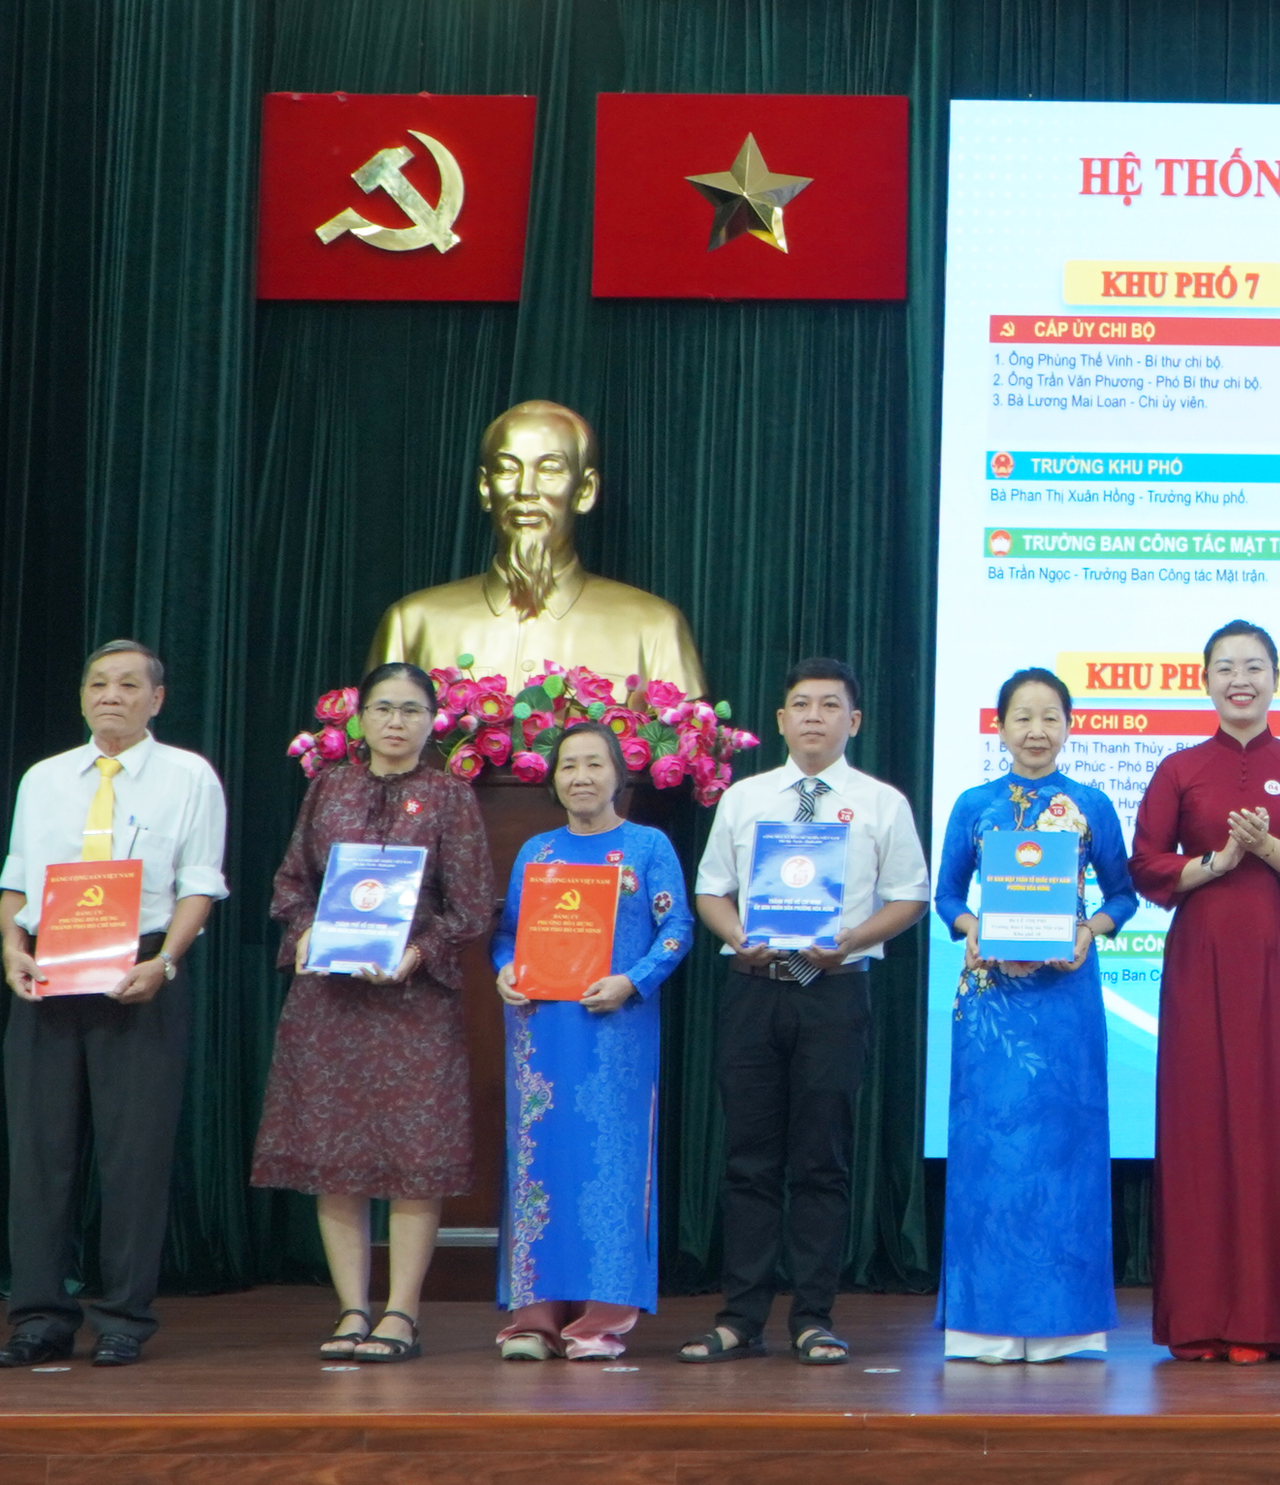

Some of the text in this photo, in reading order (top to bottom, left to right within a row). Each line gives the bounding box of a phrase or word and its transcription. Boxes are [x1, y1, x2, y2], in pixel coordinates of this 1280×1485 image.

[1079, 152, 1142, 206] HỆ
[1101, 266, 1259, 299] KHU PHỐ 7
[1034, 319, 1155, 342] CẤP ỦY CHI BỘ
[1009, 351, 1034, 368] Ông
[1038, 353, 1076, 369] Phùng
[1080, 352, 1102, 367] Thế
[1107, 355, 1133, 367] Vinh
[1145, 355, 1157, 367] Bí
[1162, 356, 1181, 368] thư
[1185, 356, 1201, 368] chi
[1206, 354, 1224, 370] bộ.
[1008, 371, 1033, 389] Ông
[1037, 372, 1063, 387] Trần
[1068, 375, 1091, 387] Văn
[1095, 374, 1144, 391] Phương
[1156, 375, 1179, 388] Phó
[1184, 376, 1195, 388] Bí
[1200, 377, 1219, 389] thư
[1224, 377, 1240, 389] chi
[1244, 377, 1261, 391] bộ.
[1022, 533, 1096, 551] TRƯỞNG
[1100, 535, 1135, 551] BAN
[1139, 534, 1188, 552] CÔNG
[1192, 535, 1226, 553] TÁC
[1230, 536, 1266, 556] MẶT
[1086, 663, 1207, 690] KHU PH
[1090, 714, 1148, 733] CHI BỘ
[1070, 742, 1163, 757] Thị Thanh Thủy
[1075, 761, 1142, 773] Phúc Phó
